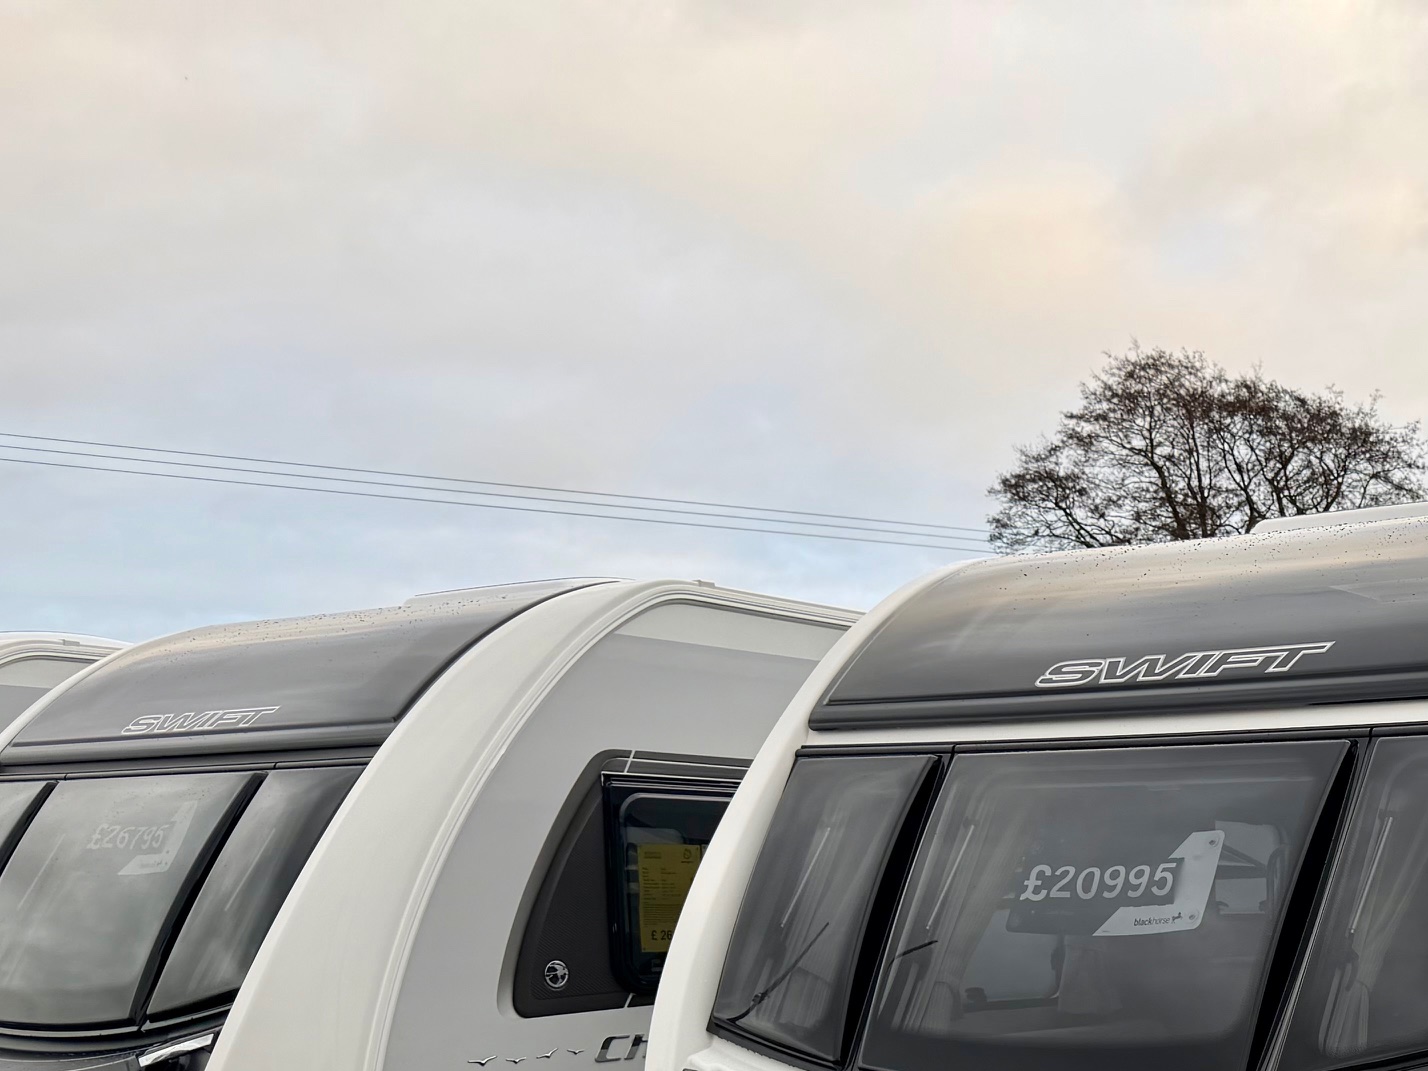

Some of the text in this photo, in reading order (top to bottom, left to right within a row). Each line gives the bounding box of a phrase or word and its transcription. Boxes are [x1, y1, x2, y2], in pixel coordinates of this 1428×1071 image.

[1035, 640, 1336, 688] SWIFT
[121, 705, 281, 735] SWIFT
[86, 823, 171, 850] £26795
[1019, 862, 1177, 902] £20995
[1133, 916, 1171, 927] blackhorse
